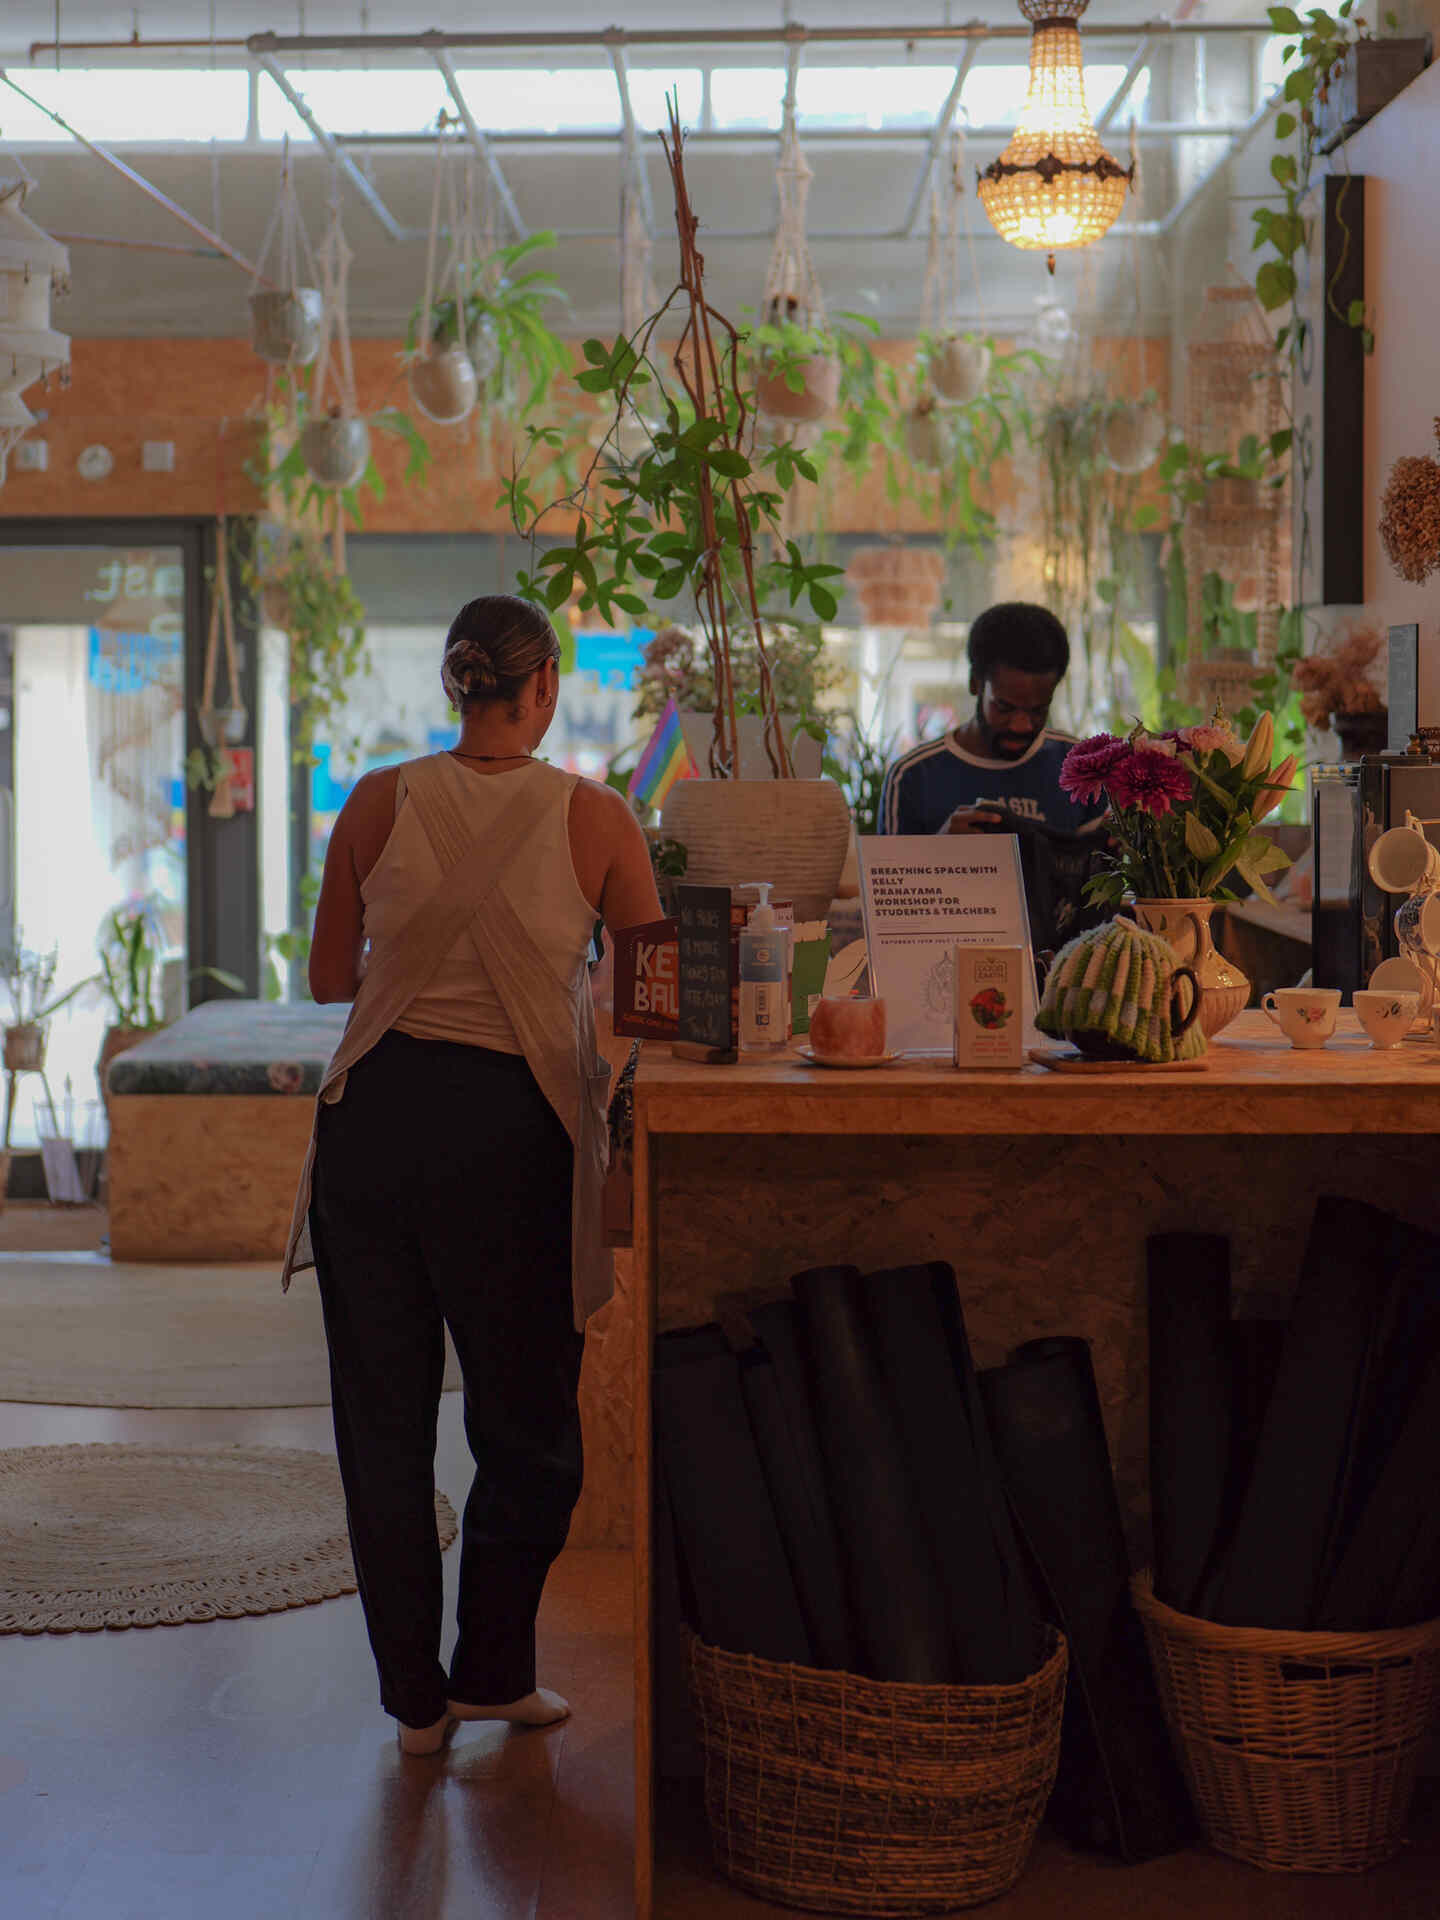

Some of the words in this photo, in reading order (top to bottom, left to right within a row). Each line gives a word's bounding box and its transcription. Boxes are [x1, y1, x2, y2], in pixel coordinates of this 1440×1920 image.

[871, 866, 932, 876] BREATHING
[934, 866, 968, 875] SPACE
[969, 865, 998, 875] WITH
[872, 877, 904, 886] KELLY
[872, 887, 943, 896] PRANAYAMA
[873, 897, 936, 907] WORKSHOP
[938, 896, 961, 905] FOR
[875, 907, 931, 917] STUDENTS
[933, 907, 941, 916] &
[941, 906, 997, 916] TEACHERS
